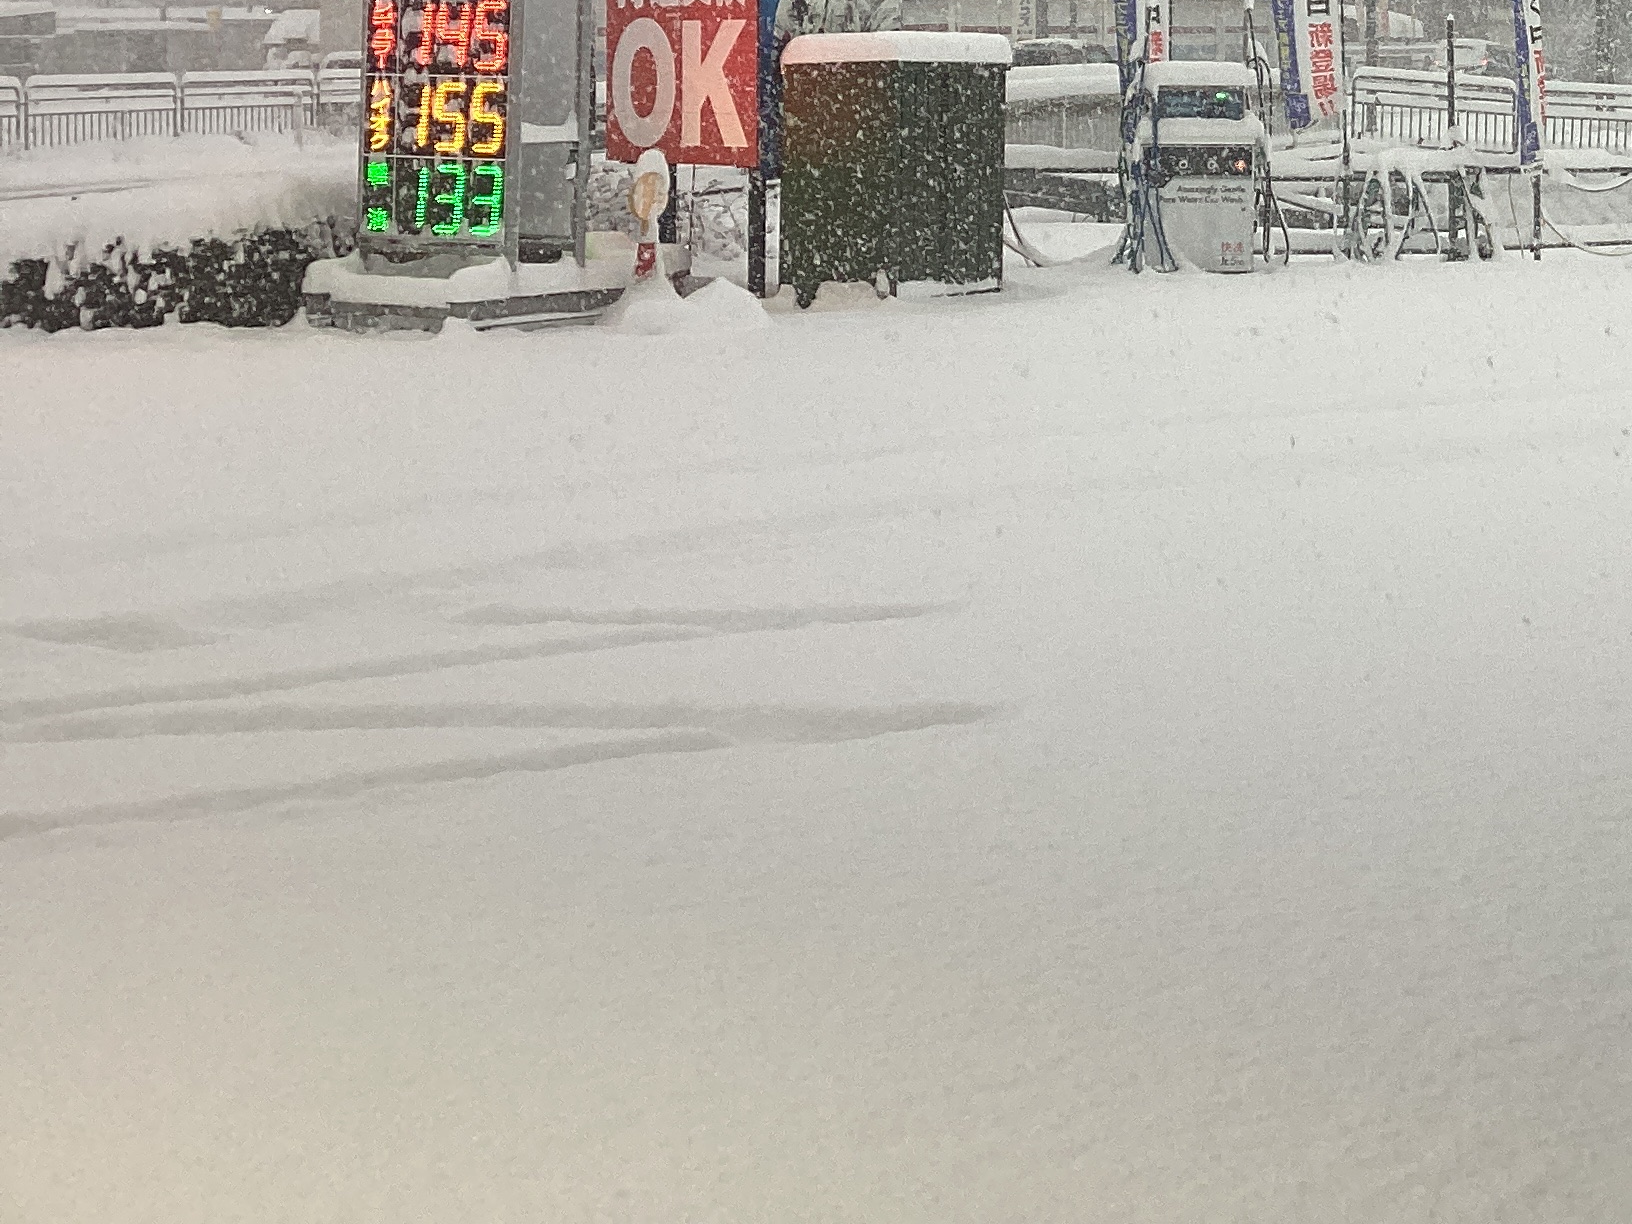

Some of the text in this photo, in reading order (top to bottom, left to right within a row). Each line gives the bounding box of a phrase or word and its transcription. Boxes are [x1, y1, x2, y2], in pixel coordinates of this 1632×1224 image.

[420, 0, 507, 71] 145
[370, 79, 391, 152] ハイオク
[416, 81, 503, 154] 155
[612, 15, 748, 148] OK
[415, 163, 503, 237] 133
